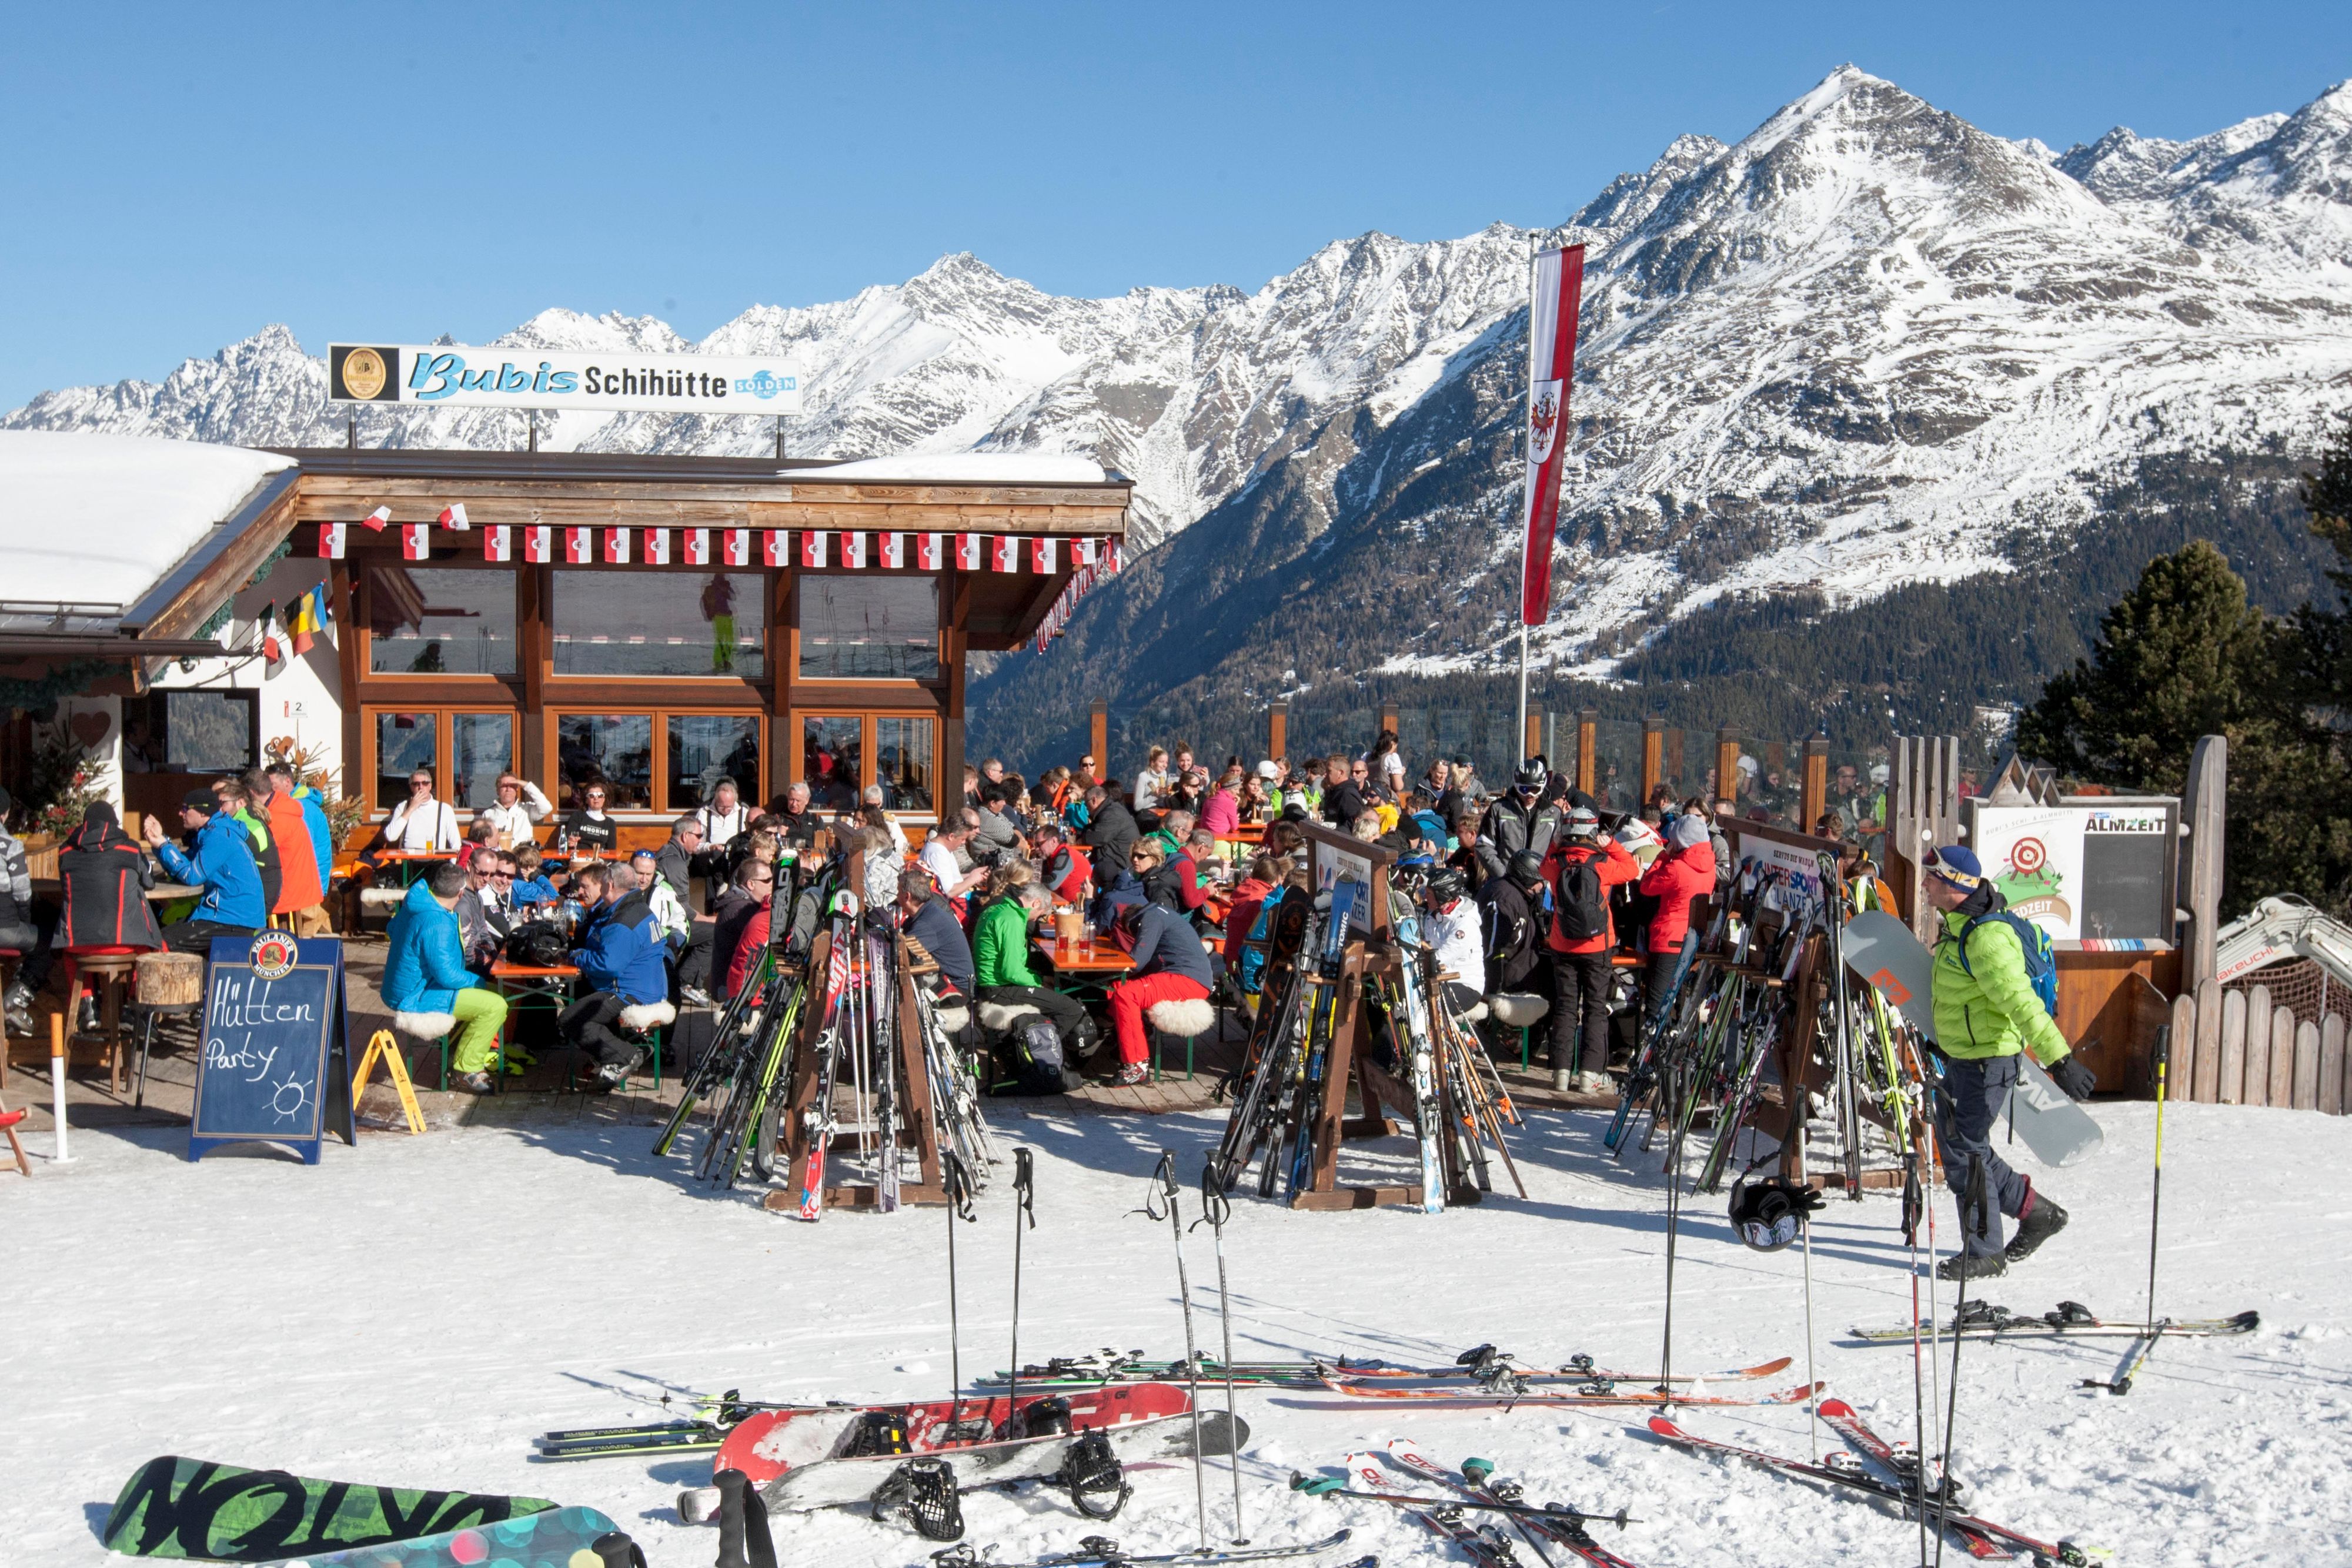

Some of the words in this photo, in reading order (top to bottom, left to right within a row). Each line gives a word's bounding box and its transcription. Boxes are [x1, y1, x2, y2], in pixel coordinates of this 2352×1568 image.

[408, 353, 579, 400] Bubis
[585, 366, 727, 397] Schihütte
[296, 702, 302, 711] 2
[2084, 818, 2166, 831] ALMZEIT
[770, 868, 791, 944] HEAD
[2012, 900, 2052, 918] GDZEIT
[252, 934, 294, 953] PAULANER
[1337, 911, 1349, 955] ATOMIC
[212, 976, 314, 1028] Hütten
[206, 1032, 279, 1081] Party
